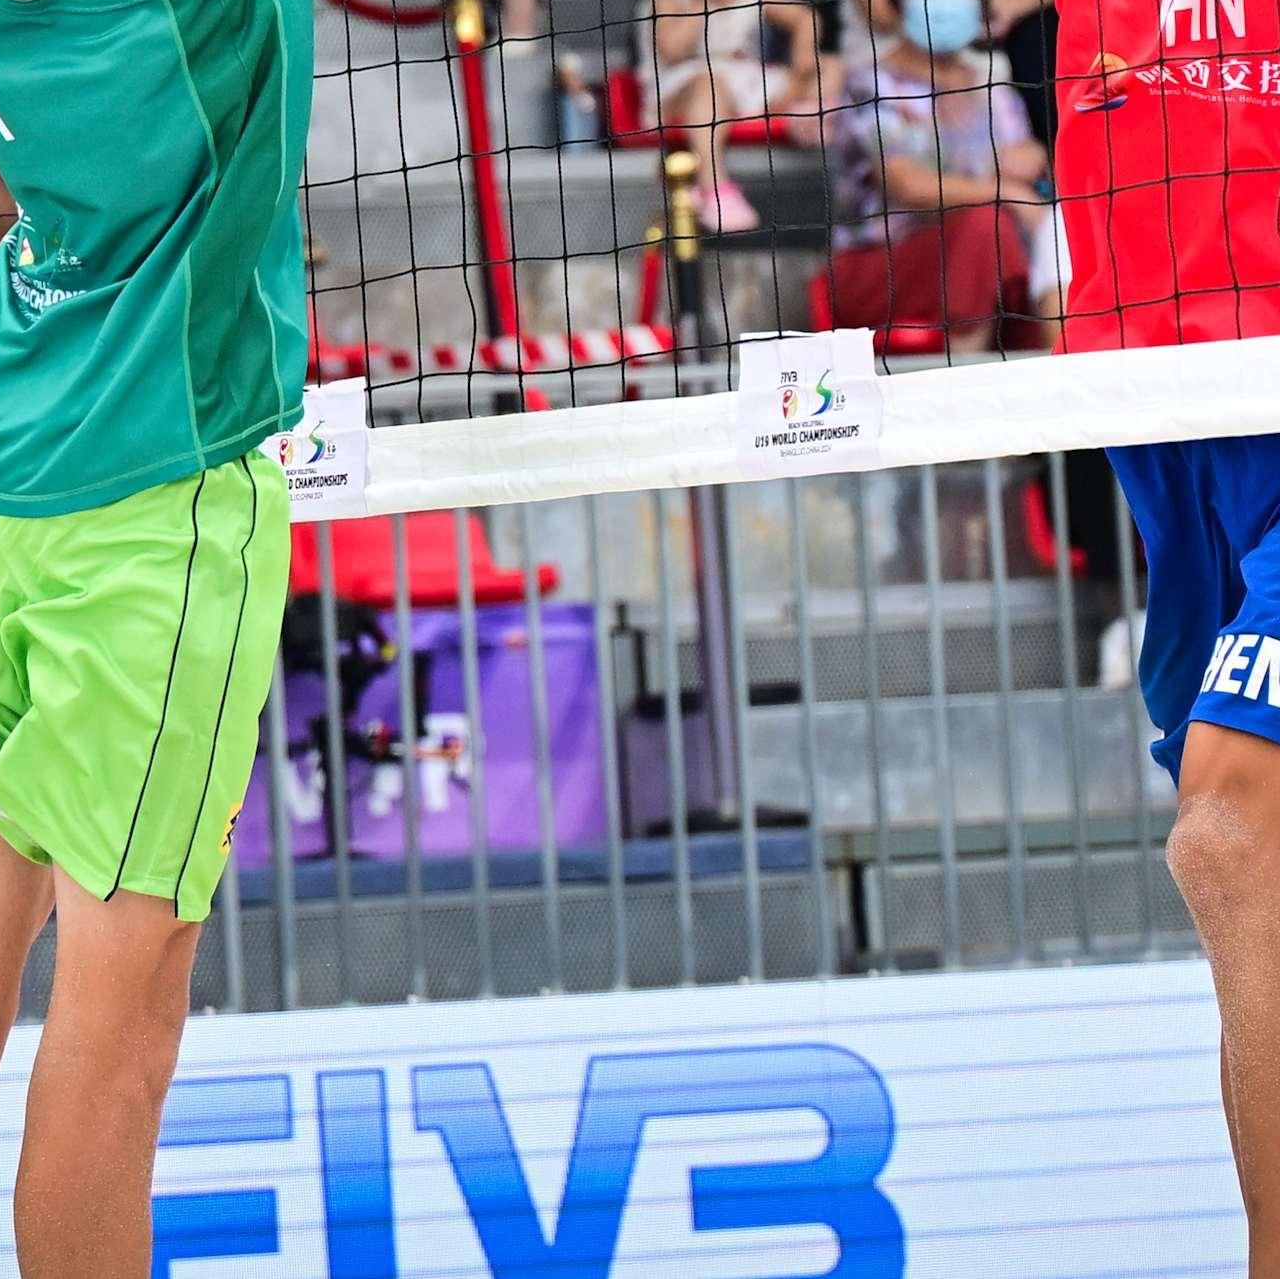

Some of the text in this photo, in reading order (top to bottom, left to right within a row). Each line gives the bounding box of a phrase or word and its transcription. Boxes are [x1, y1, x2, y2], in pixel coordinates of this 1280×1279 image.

[780, 371, 798, 384] FIVB
[755, 424, 860, 449] U19 WORLD CHAMPIONSHIPS
[294, 473, 348, 490] CHAMPIONSHIPS
[150, 1042, 906, 1279] FIVB
